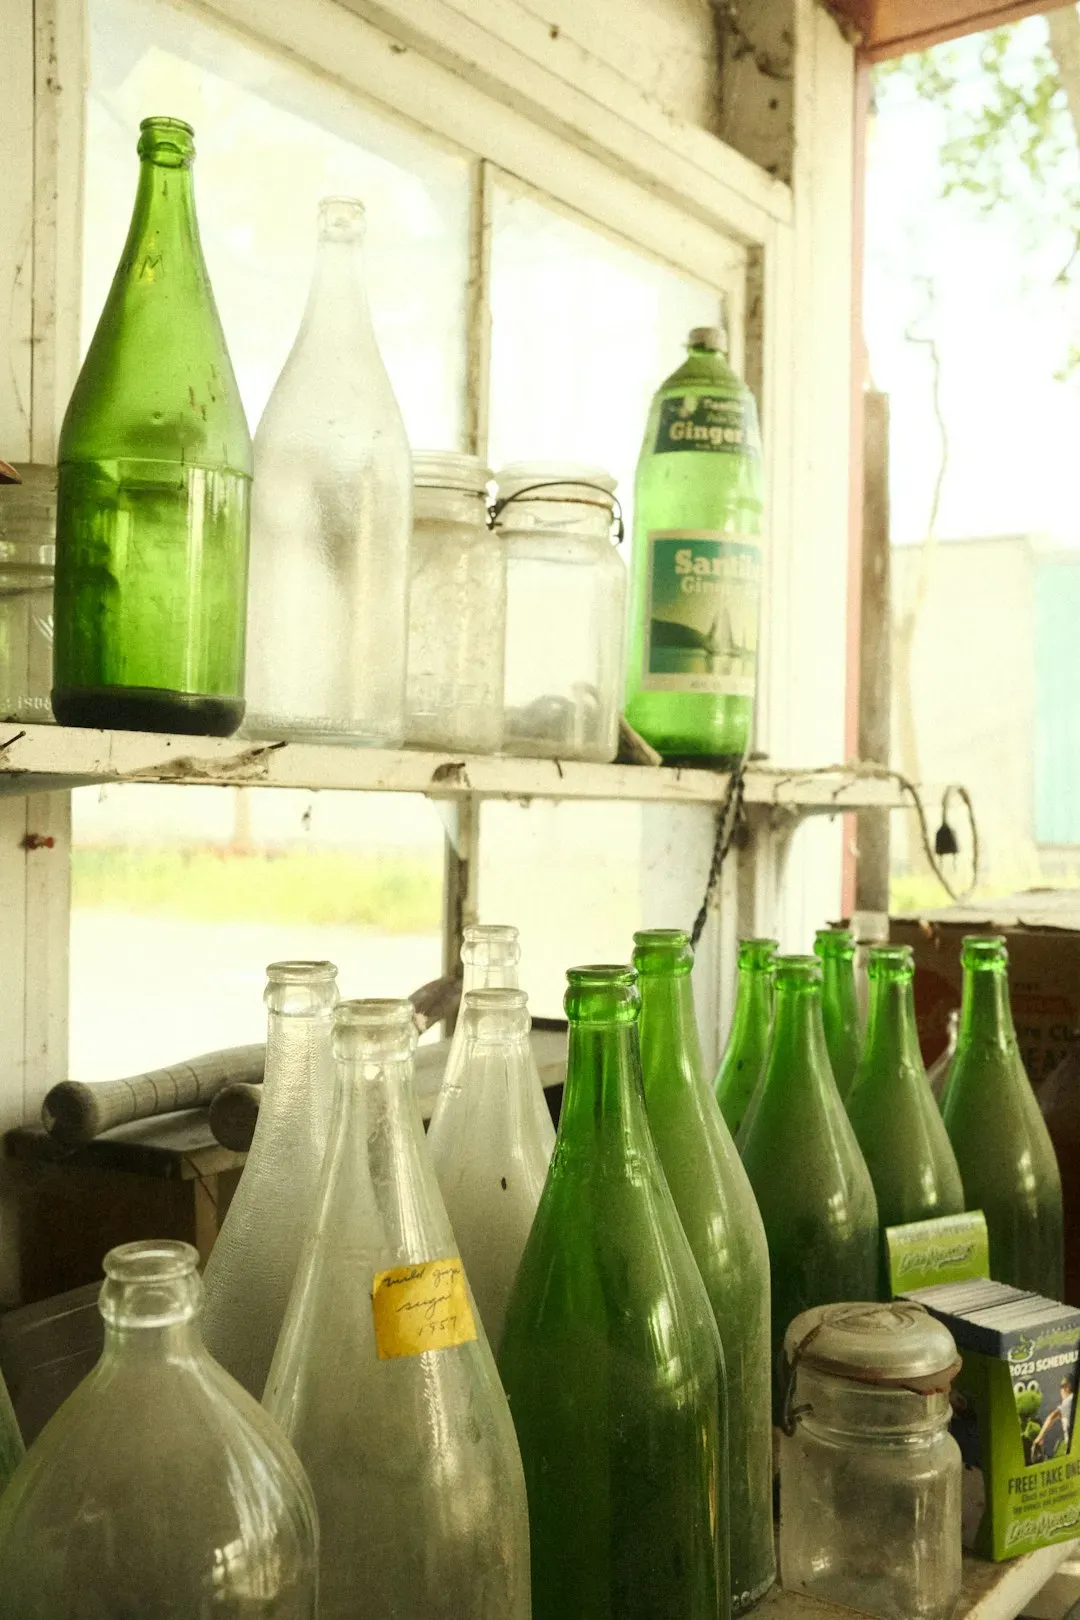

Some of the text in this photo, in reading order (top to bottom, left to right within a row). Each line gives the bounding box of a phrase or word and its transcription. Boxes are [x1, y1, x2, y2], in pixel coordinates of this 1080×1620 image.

[668, 421, 743, 446] Ginger
[418, 1316, 457, 1337] 1957
[1008, 1360, 1035, 1376] 2023
[1007, 1472, 1037, 1494] FREE!
[1040, 1466, 1063, 1486] TAKE
